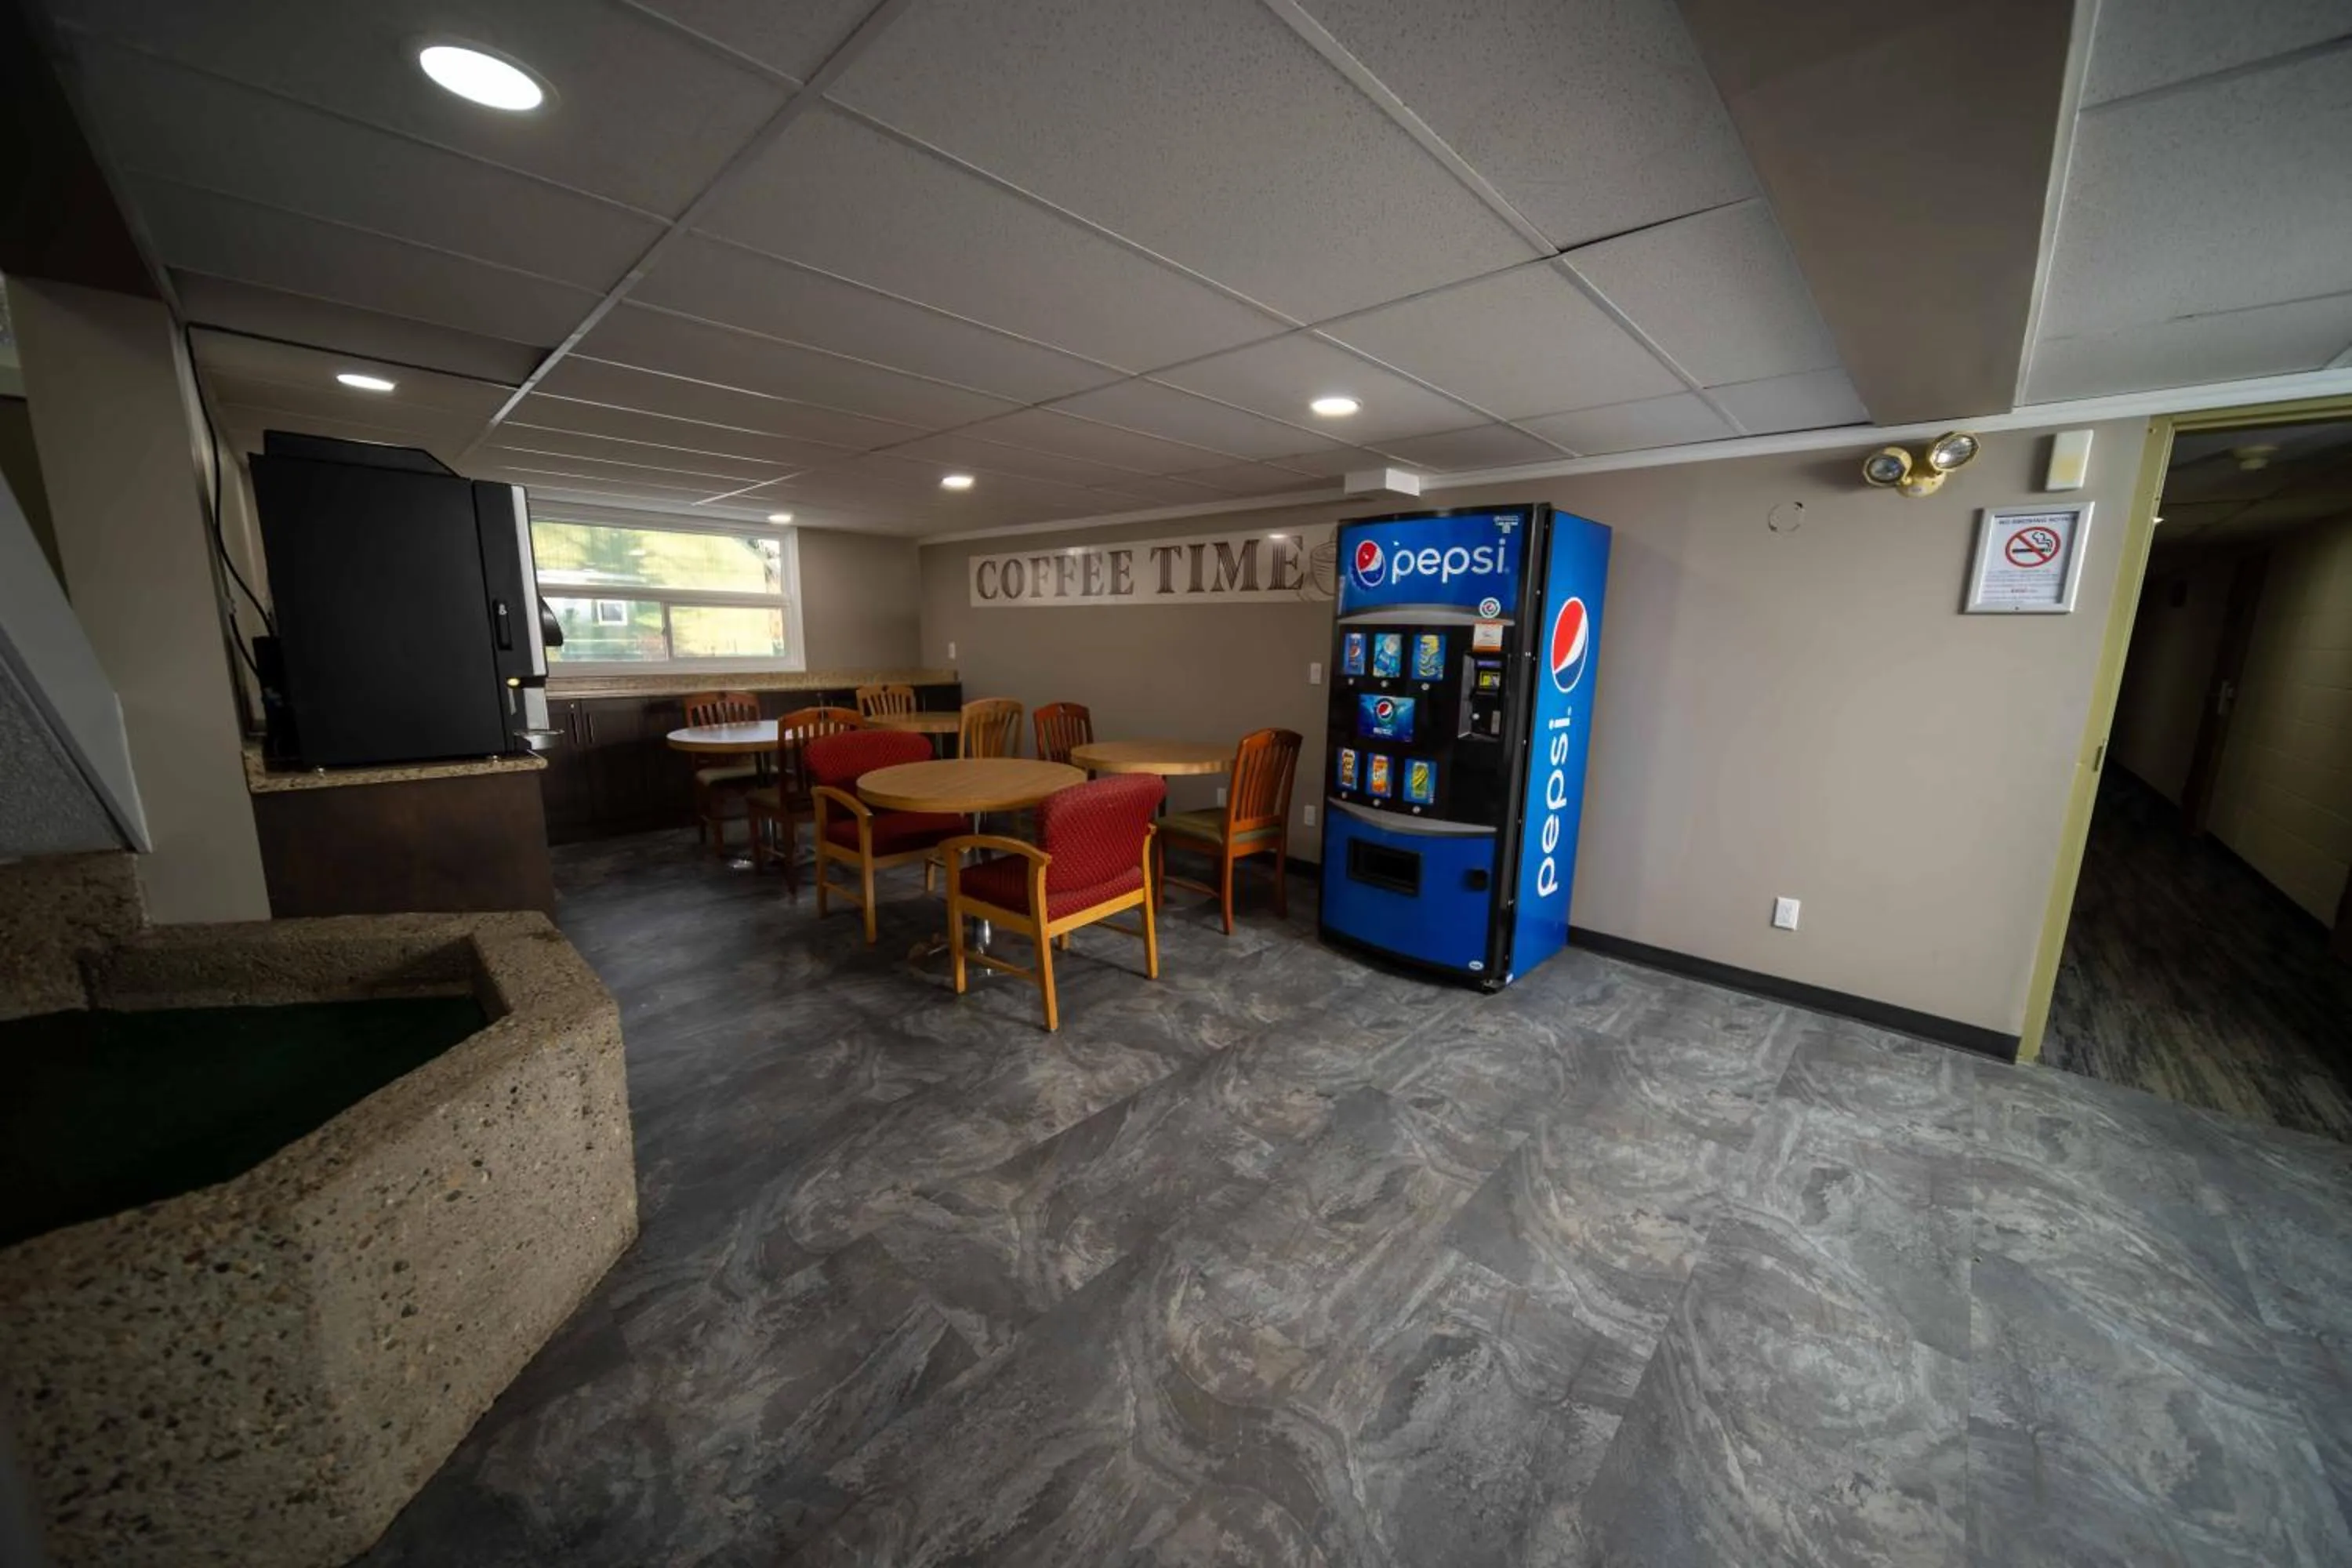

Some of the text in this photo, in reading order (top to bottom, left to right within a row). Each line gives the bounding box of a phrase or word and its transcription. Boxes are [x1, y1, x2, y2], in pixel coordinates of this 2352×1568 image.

[976, 535, 1304, 599] COFFEE TIME
[1391, 538, 1506, 584] pepsi
[1537, 717, 1570, 897] pepsi
